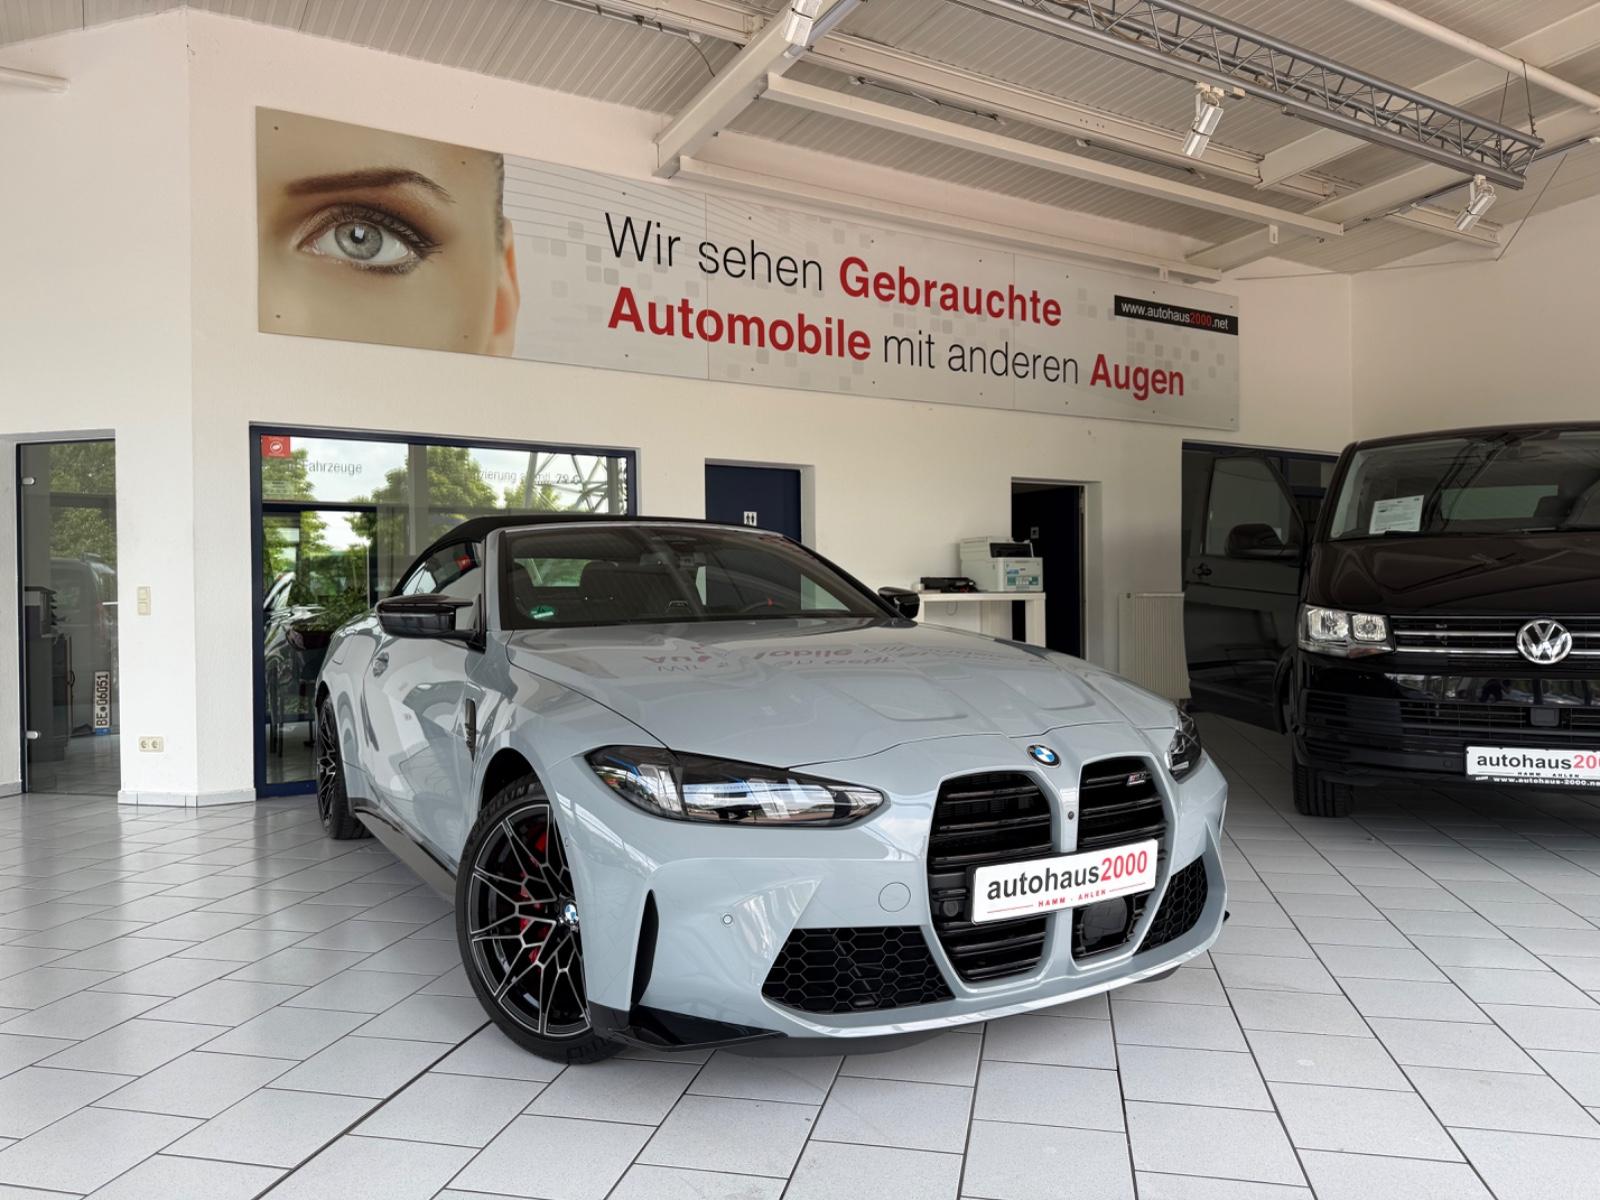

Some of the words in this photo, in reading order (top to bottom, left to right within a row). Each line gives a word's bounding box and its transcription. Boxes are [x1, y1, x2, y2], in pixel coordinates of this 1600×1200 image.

[605, 213, 680, 267] Wir
[698, 239, 823, 291] sehen
[839, 256, 1062, 327] Gebrauchte
[1120, 301, 1229, 331] www.autohaus2000.net
[608, 287, 871, 361] Automobile
[884, 333, 936, 369] mit
[948, 342, 1079, 384] anderen
[1090, 353, 1185, 401] Augen
[1477, 753, 1600, 770] autohaus20
[987, 850, 1148, 901] autohaus2000
[1037, 897, 1067, 908] HAMM
[1077, 888, 1108, 902] AHLEN
